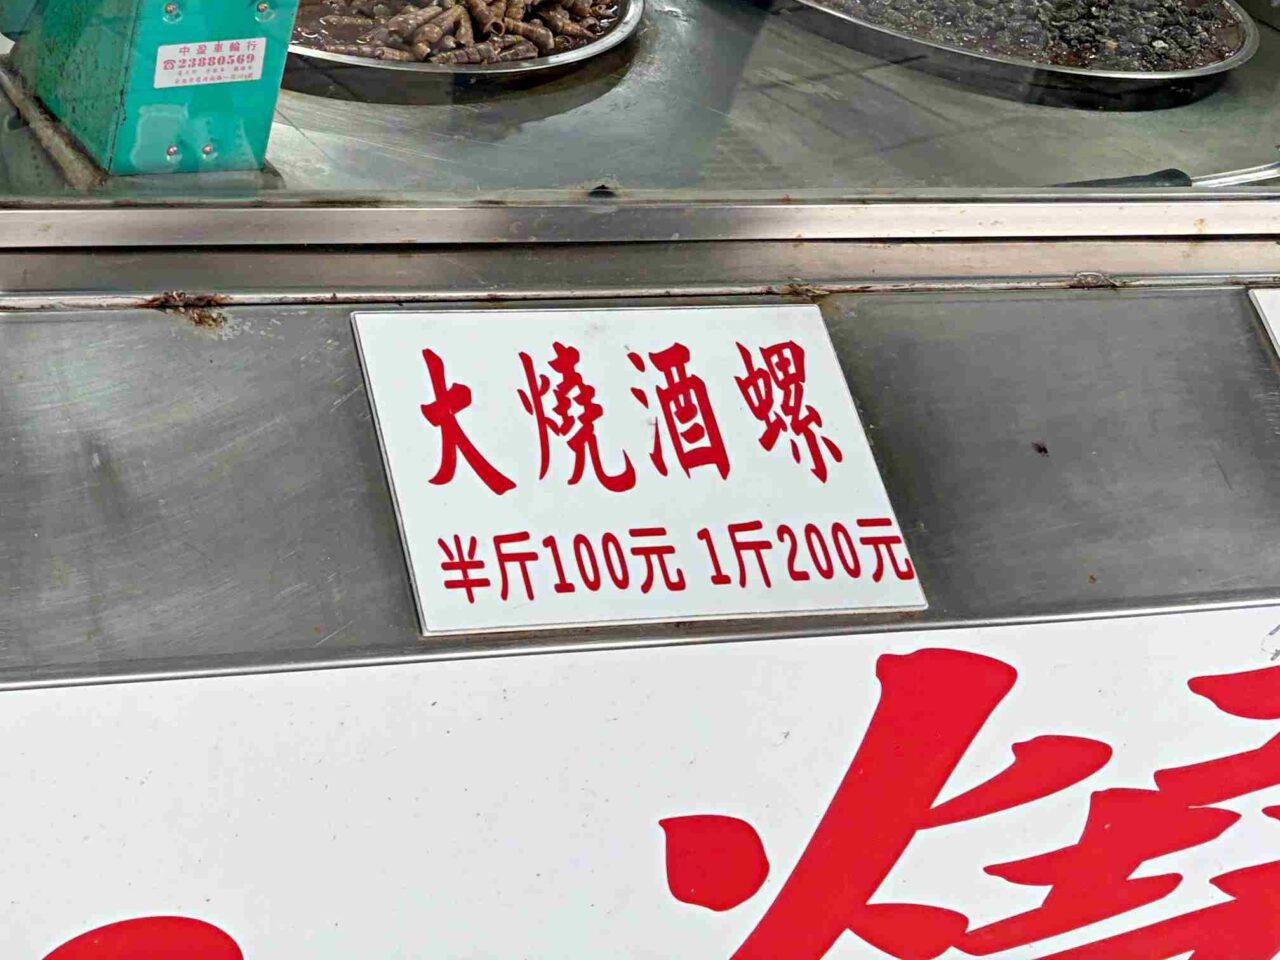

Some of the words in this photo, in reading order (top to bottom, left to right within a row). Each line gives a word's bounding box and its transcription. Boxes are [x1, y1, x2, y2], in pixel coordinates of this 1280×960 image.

[178, 53, 256, 69] 23880569
[437, 527, 686, 604] 半斤100元
[696, 518, 916, 589] 1斤200元
